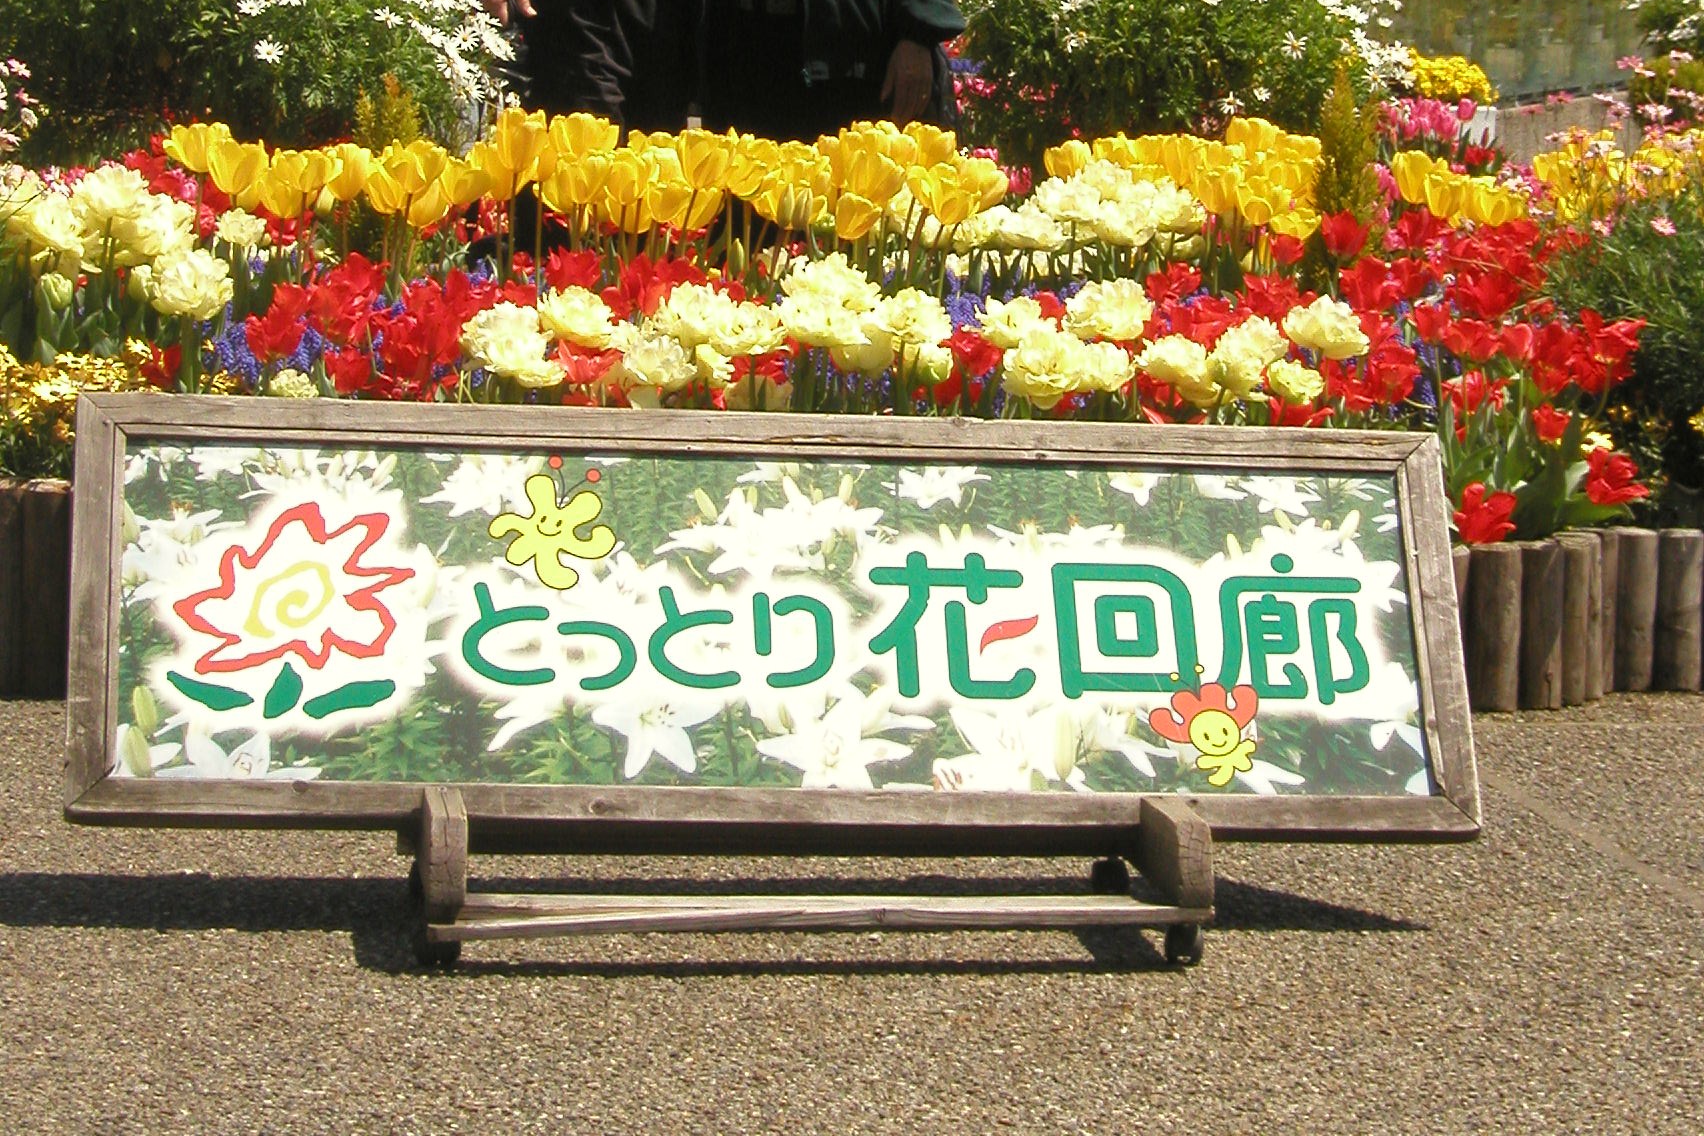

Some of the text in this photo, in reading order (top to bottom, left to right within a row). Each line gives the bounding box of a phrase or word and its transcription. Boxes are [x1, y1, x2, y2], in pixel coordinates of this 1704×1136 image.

[462, 551, 1369, 705] とっとり花回廊
